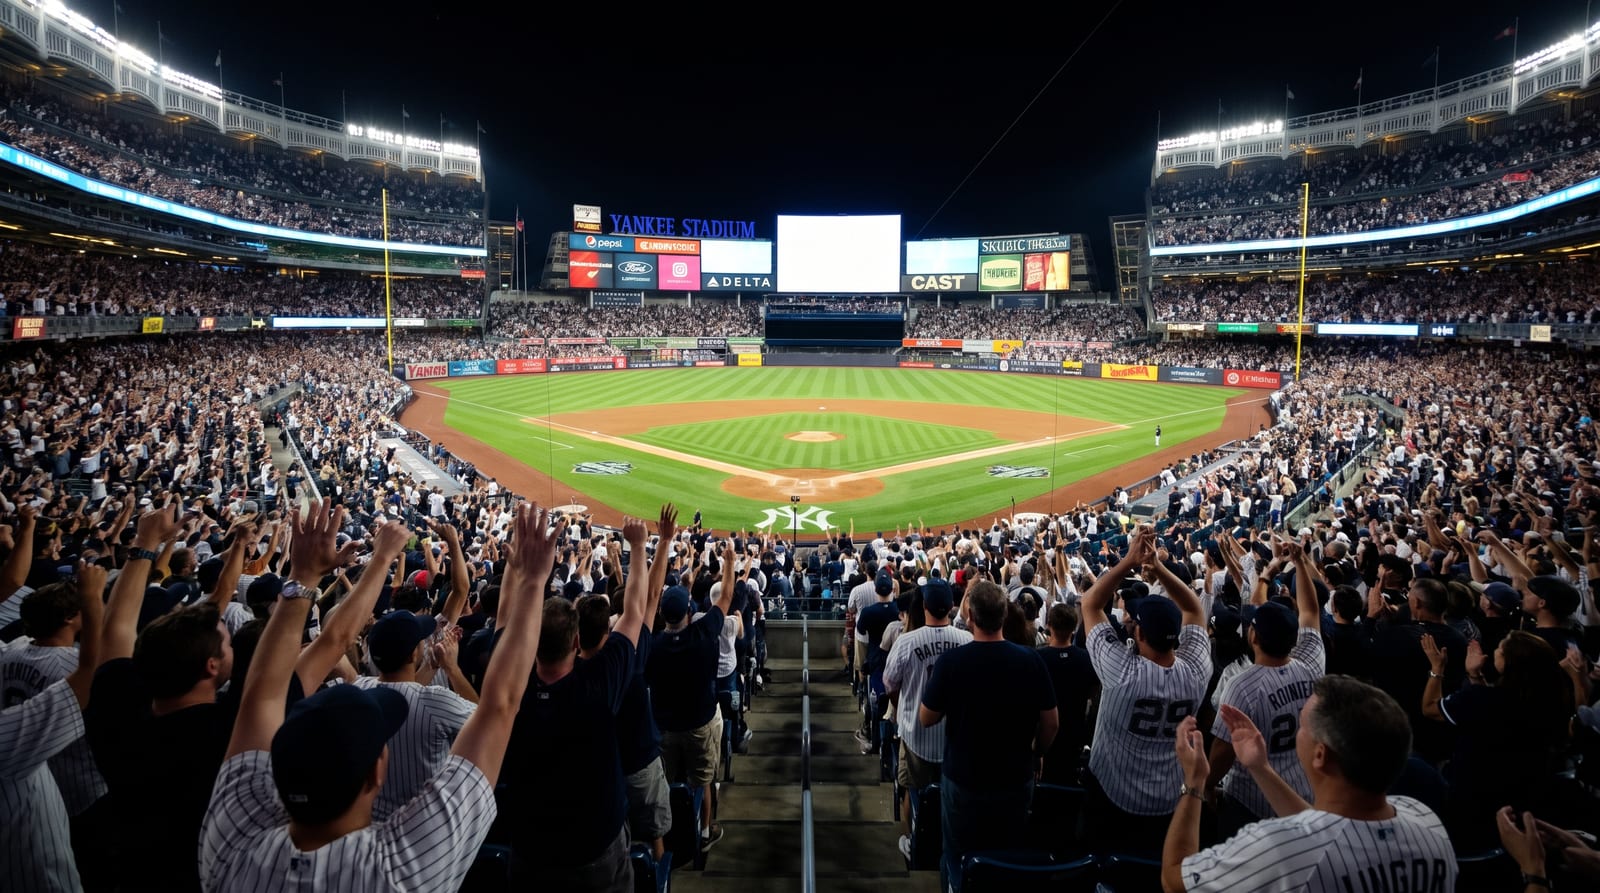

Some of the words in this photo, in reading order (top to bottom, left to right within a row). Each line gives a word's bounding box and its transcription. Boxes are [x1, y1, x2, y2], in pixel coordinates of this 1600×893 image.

[610, 213, 676, 236] YANKEE
[681, 218, 756, 239] STADIUM
[598, 239, 623, 249] pepsi
[624, 262, 647, 273] Ford
[722, 276, 771, 288] DELTA
[911, 275, 966, 290] CAST
